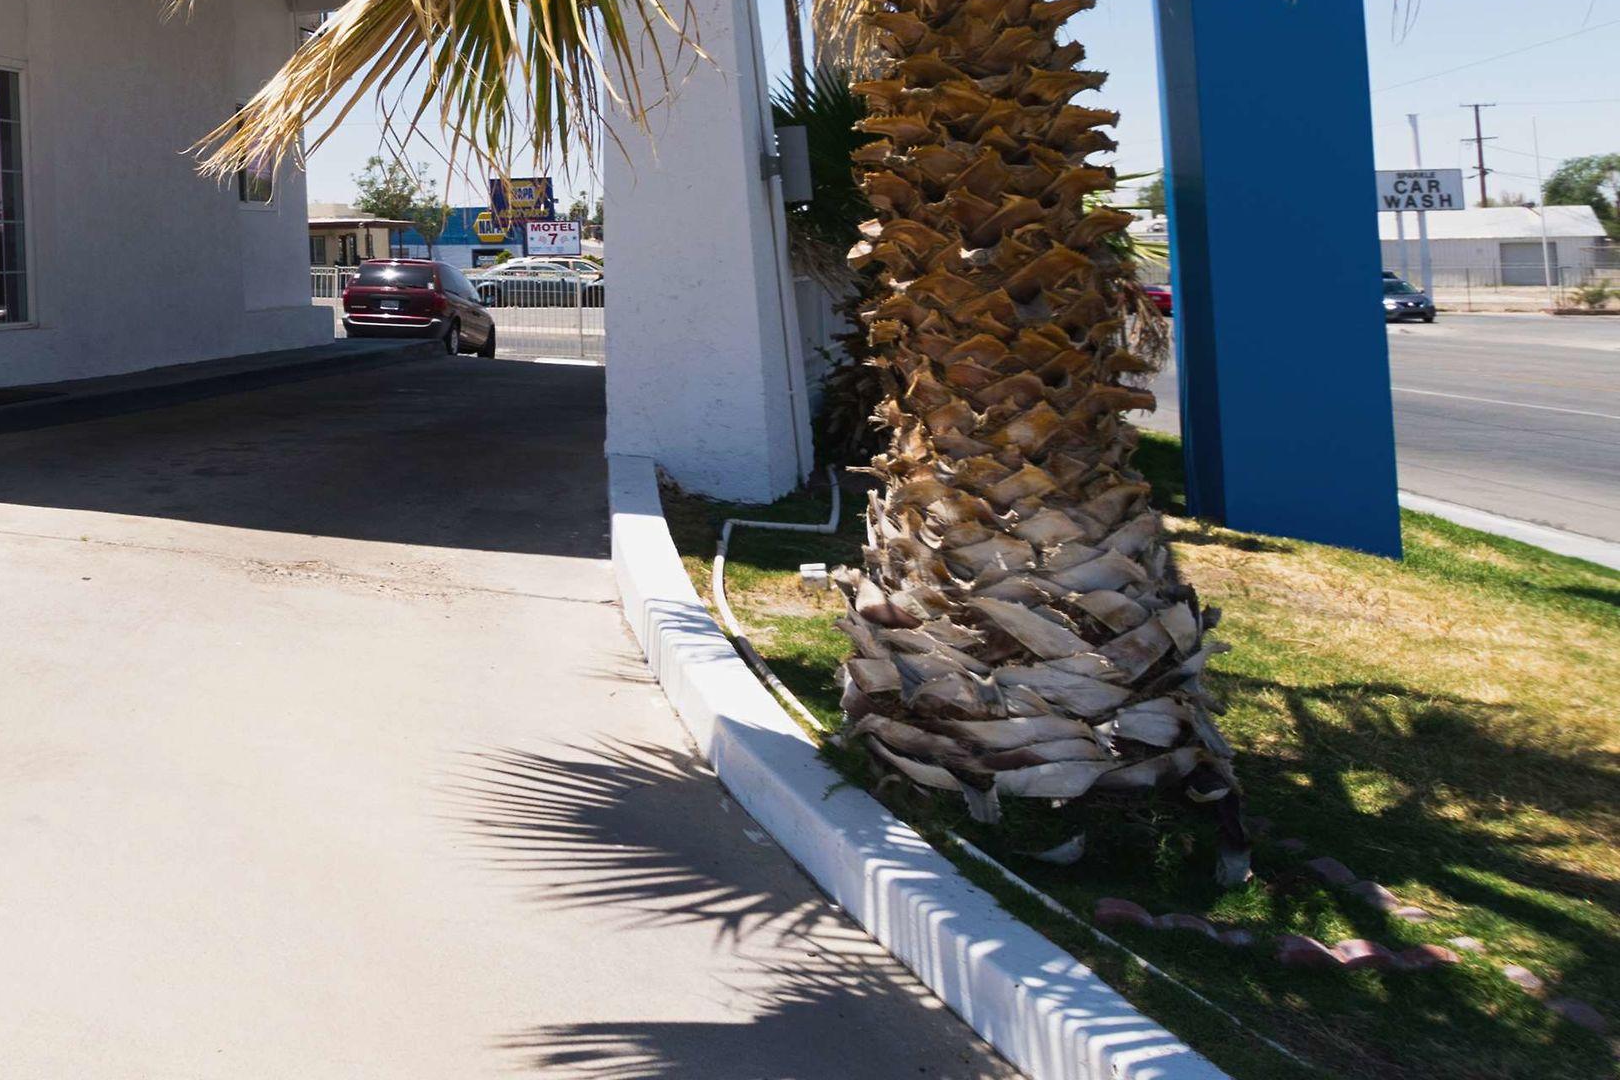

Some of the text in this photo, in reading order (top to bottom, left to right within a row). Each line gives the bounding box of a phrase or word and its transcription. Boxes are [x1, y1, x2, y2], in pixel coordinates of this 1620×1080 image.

[1393, 179, 1440, 194] CAR
[1383, 193, 1453, 209] WASH
[530, 223, 575, 232] MOTEL
[548, 233, 558, 245] 7
